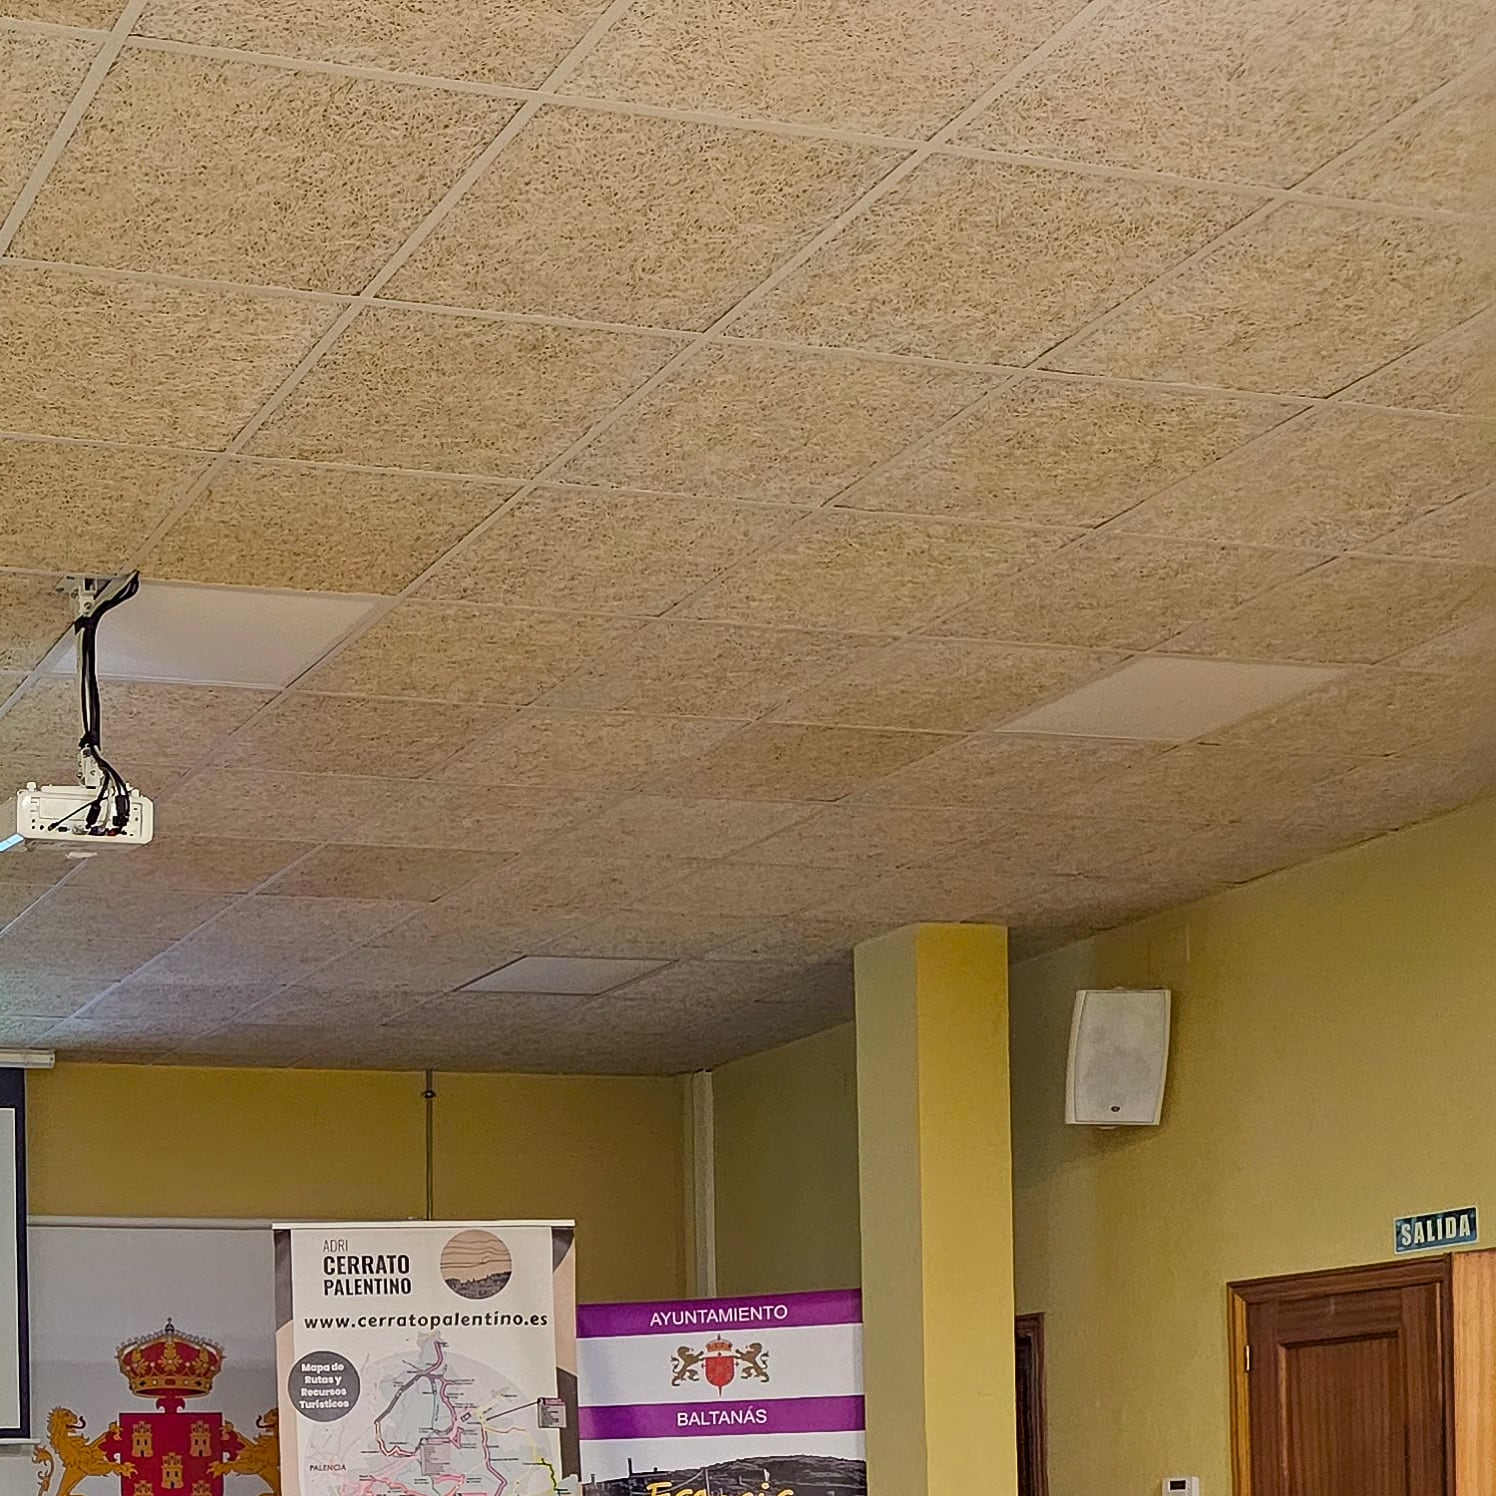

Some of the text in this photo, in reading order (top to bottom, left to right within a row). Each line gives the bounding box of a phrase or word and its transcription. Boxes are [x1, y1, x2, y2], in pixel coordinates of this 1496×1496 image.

[1401, 1214, 1471, 1246] SALIDA
[323, 1239, 349, 1253] ADRI
[323, 1254, 410, 1275] CERRATO
[323, 1277, 412, 1296] PALENTINO
[304, 1311, 548, 1330] www.cerratopalentino.es
[650, 1305, 788, 1327] AYUNTAMIENTO
[301, 1363, 330, 1374] Mapa
[304, 1375, 342, 1386] Rutas y
[300, 1388, 347, 1397] Recursos
[299, 1399, 350, 1409] Turísticos
[677, 1406, 768, 1427] BALTANÁS
